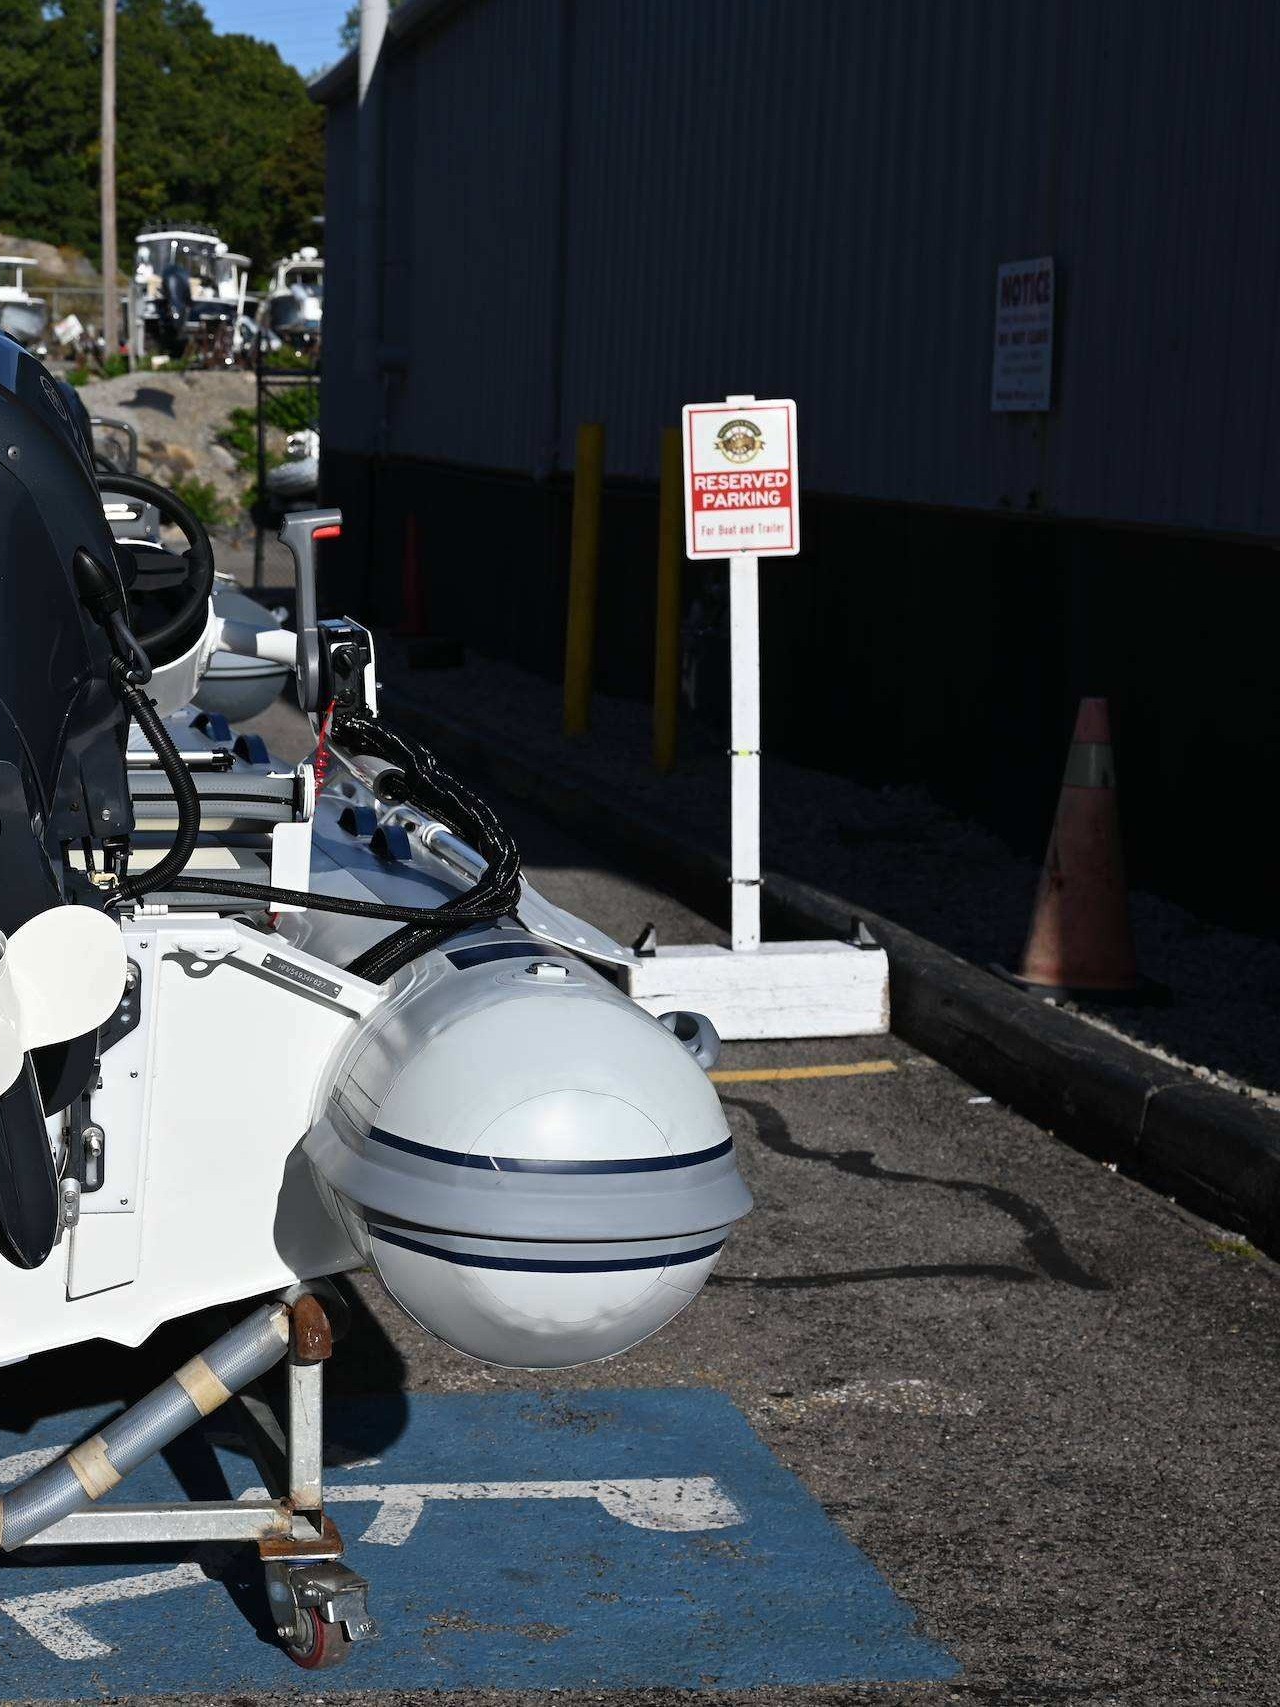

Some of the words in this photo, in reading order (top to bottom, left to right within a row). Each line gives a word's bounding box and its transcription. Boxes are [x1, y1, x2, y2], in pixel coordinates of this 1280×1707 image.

[1001, 270, 1051, 307] NOTICE
[694, 472, 789, 491] RESERVED
[702, 489, 782, 509] PARKING
[701, 525, 715, 536] For
[718, 524, 737, 536] Boat
[740, 525, 754, 535] and
[758, 522, 785, 534] Trailer
